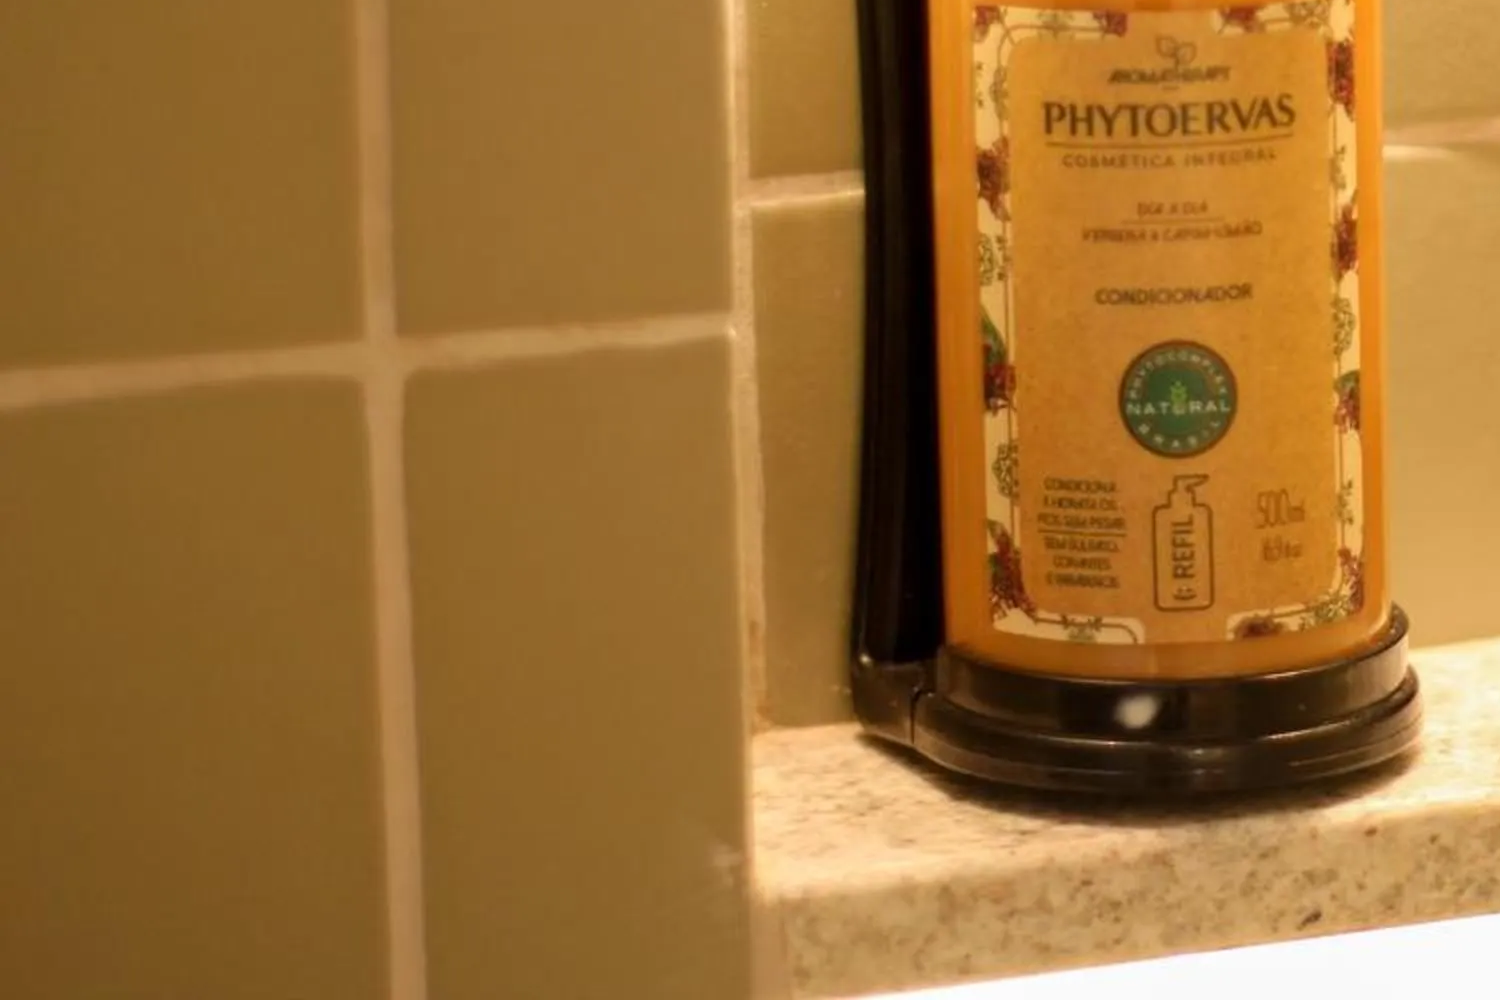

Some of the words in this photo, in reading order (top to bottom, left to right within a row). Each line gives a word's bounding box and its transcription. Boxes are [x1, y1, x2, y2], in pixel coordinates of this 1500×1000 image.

[1043, 94, 1296, 137] PHYTOERVAS
[1095, 283, 1253, 305] CONDICIONADOR
[1126, 400, 1231, 416] NATURAL
[1171, 514, 1195, 579] REFIL
